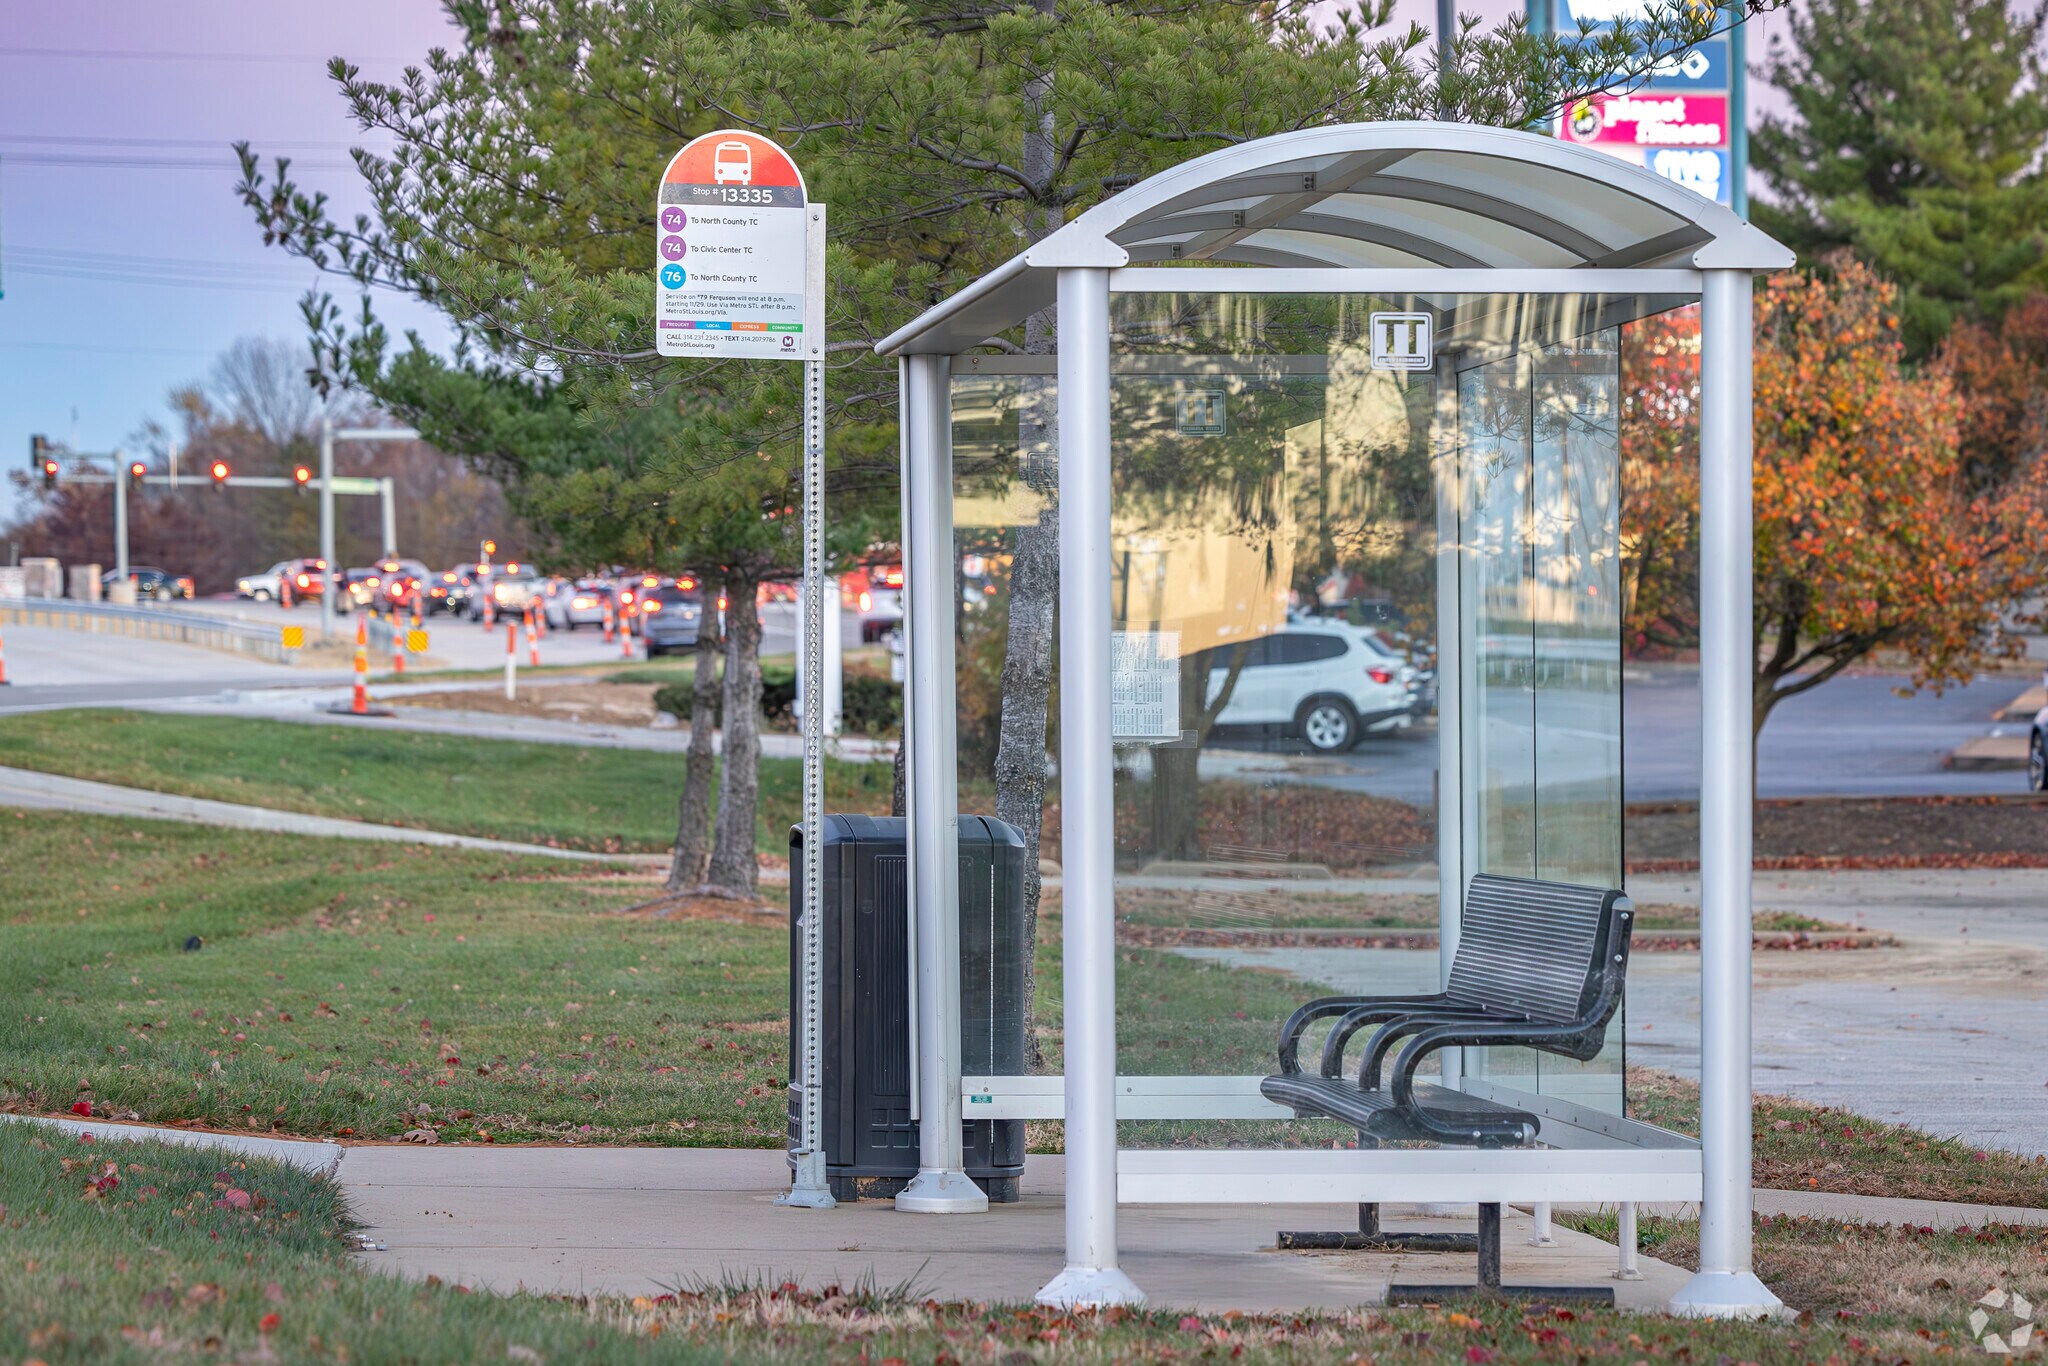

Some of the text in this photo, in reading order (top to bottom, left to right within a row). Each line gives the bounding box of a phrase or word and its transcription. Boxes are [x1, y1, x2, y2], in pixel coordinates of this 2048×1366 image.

[693, 188, 710, 196] Stop
[721, 189, 773, 203] 13335
[666, 215, 681, 225] 74
[722, 218, 747, 226] County
[666, 243, 681, 253] 74
[666, 272, 681, 282] 76
[722, 275, 746, 283] County
